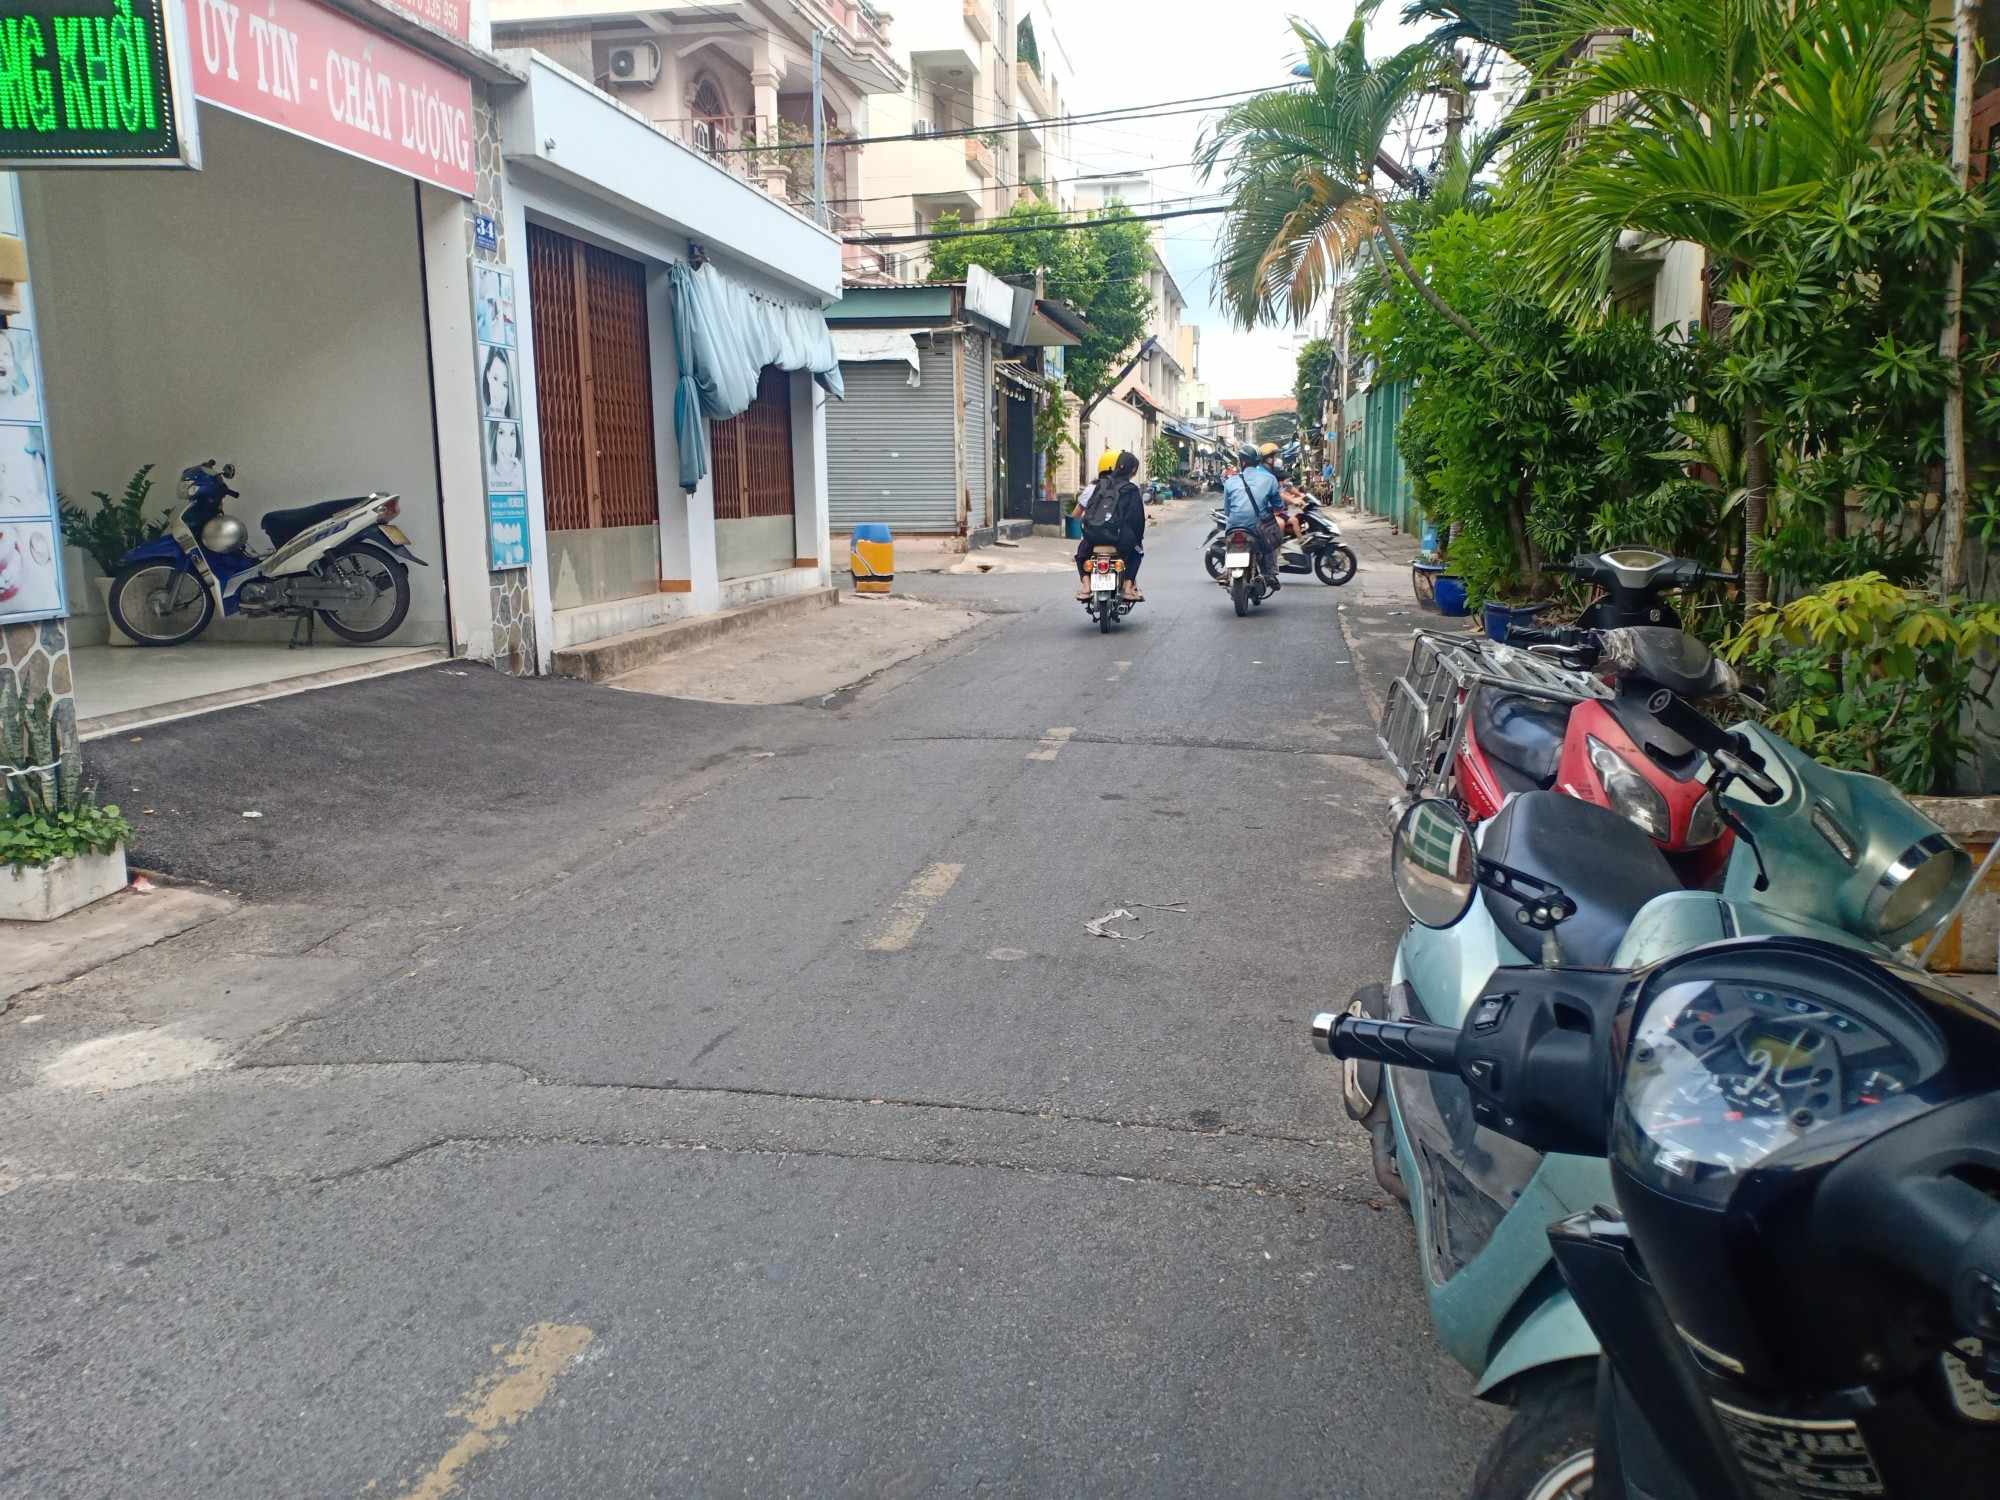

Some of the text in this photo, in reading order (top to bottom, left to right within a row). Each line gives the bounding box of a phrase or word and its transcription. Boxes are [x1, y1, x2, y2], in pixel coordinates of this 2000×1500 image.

[199, 0, 239, 81] UY
[250, 0, 300, 104] TÍN
[325, 39, 392, 140] CHẤT
[399, 81, 470, 174] LƯỢNG
[476, 217, 494, 239] 34
